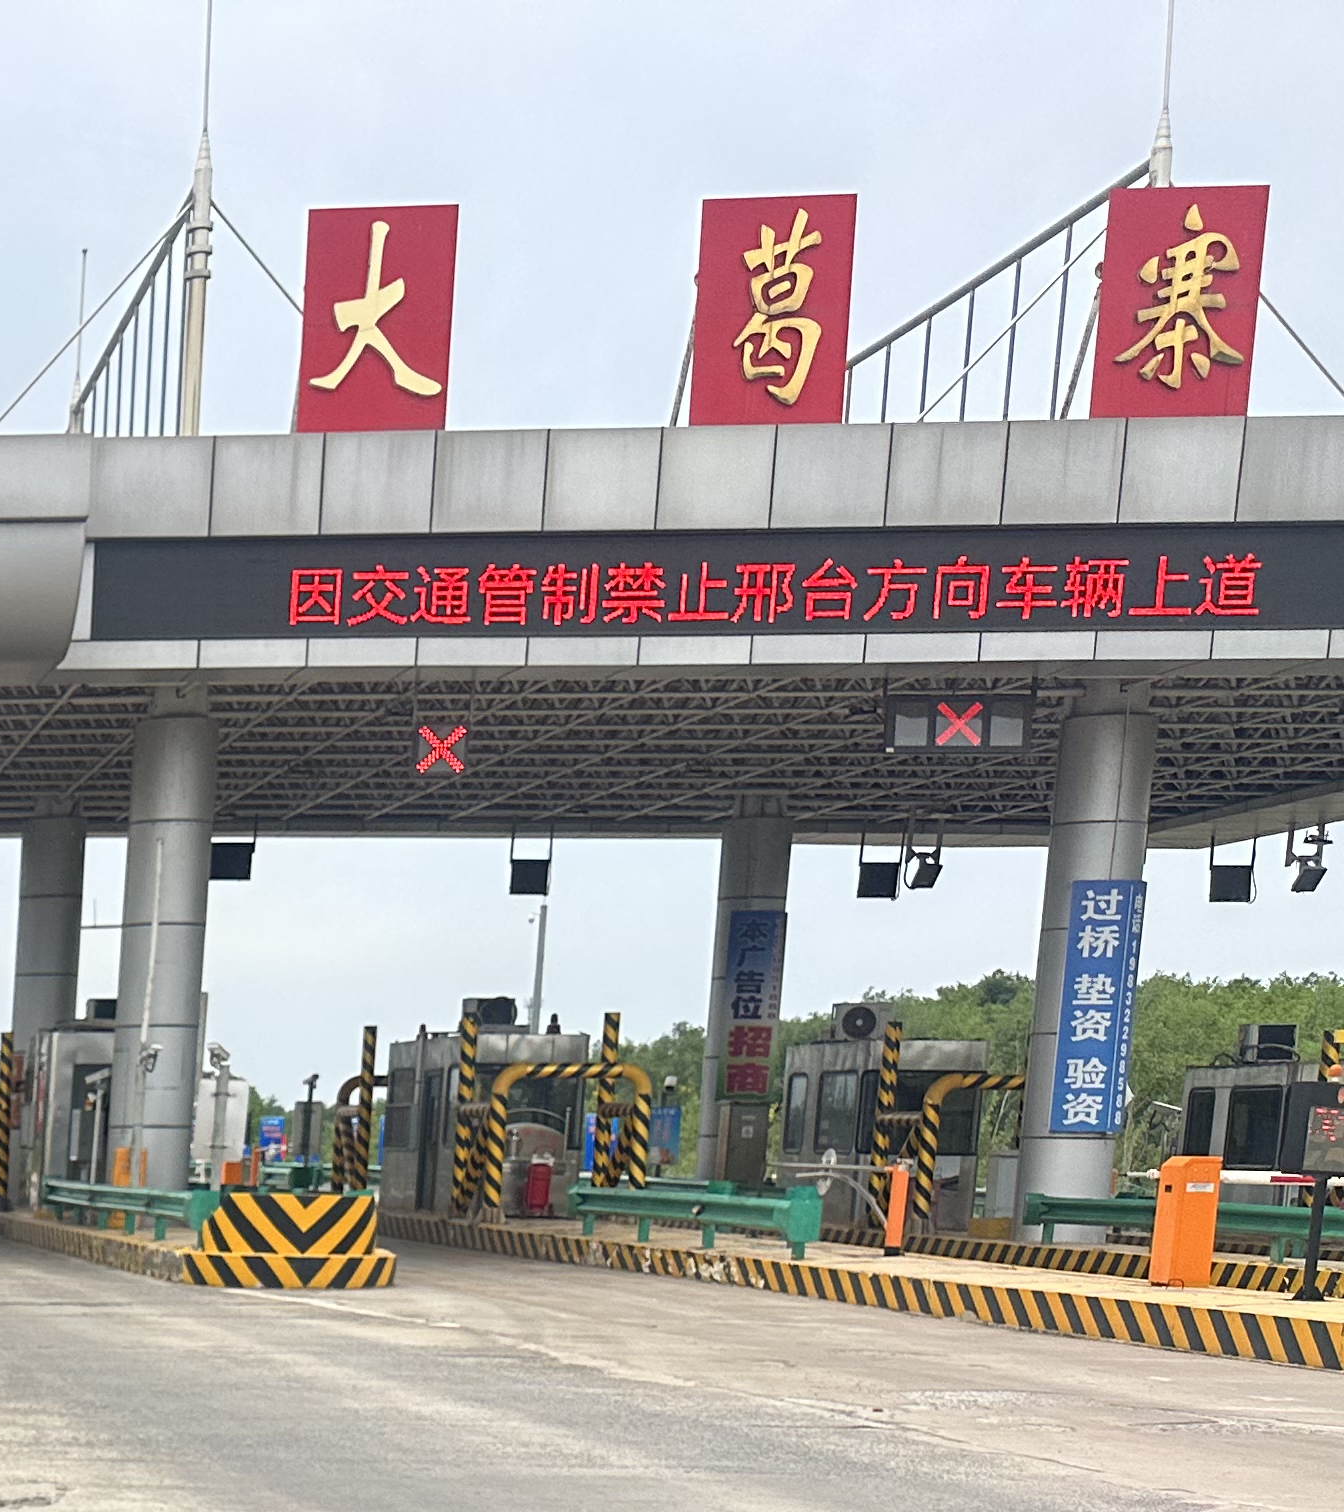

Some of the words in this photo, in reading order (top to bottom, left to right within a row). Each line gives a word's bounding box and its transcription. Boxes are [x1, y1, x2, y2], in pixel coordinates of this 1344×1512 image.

[309, 220, 443, 398] 大
[732, 207, 823, 407] 葛
[1112, 204, 1246, 391] 寨
[288, 553, 1263, 627] 因交通管制禁止邢台方向车辆上道
